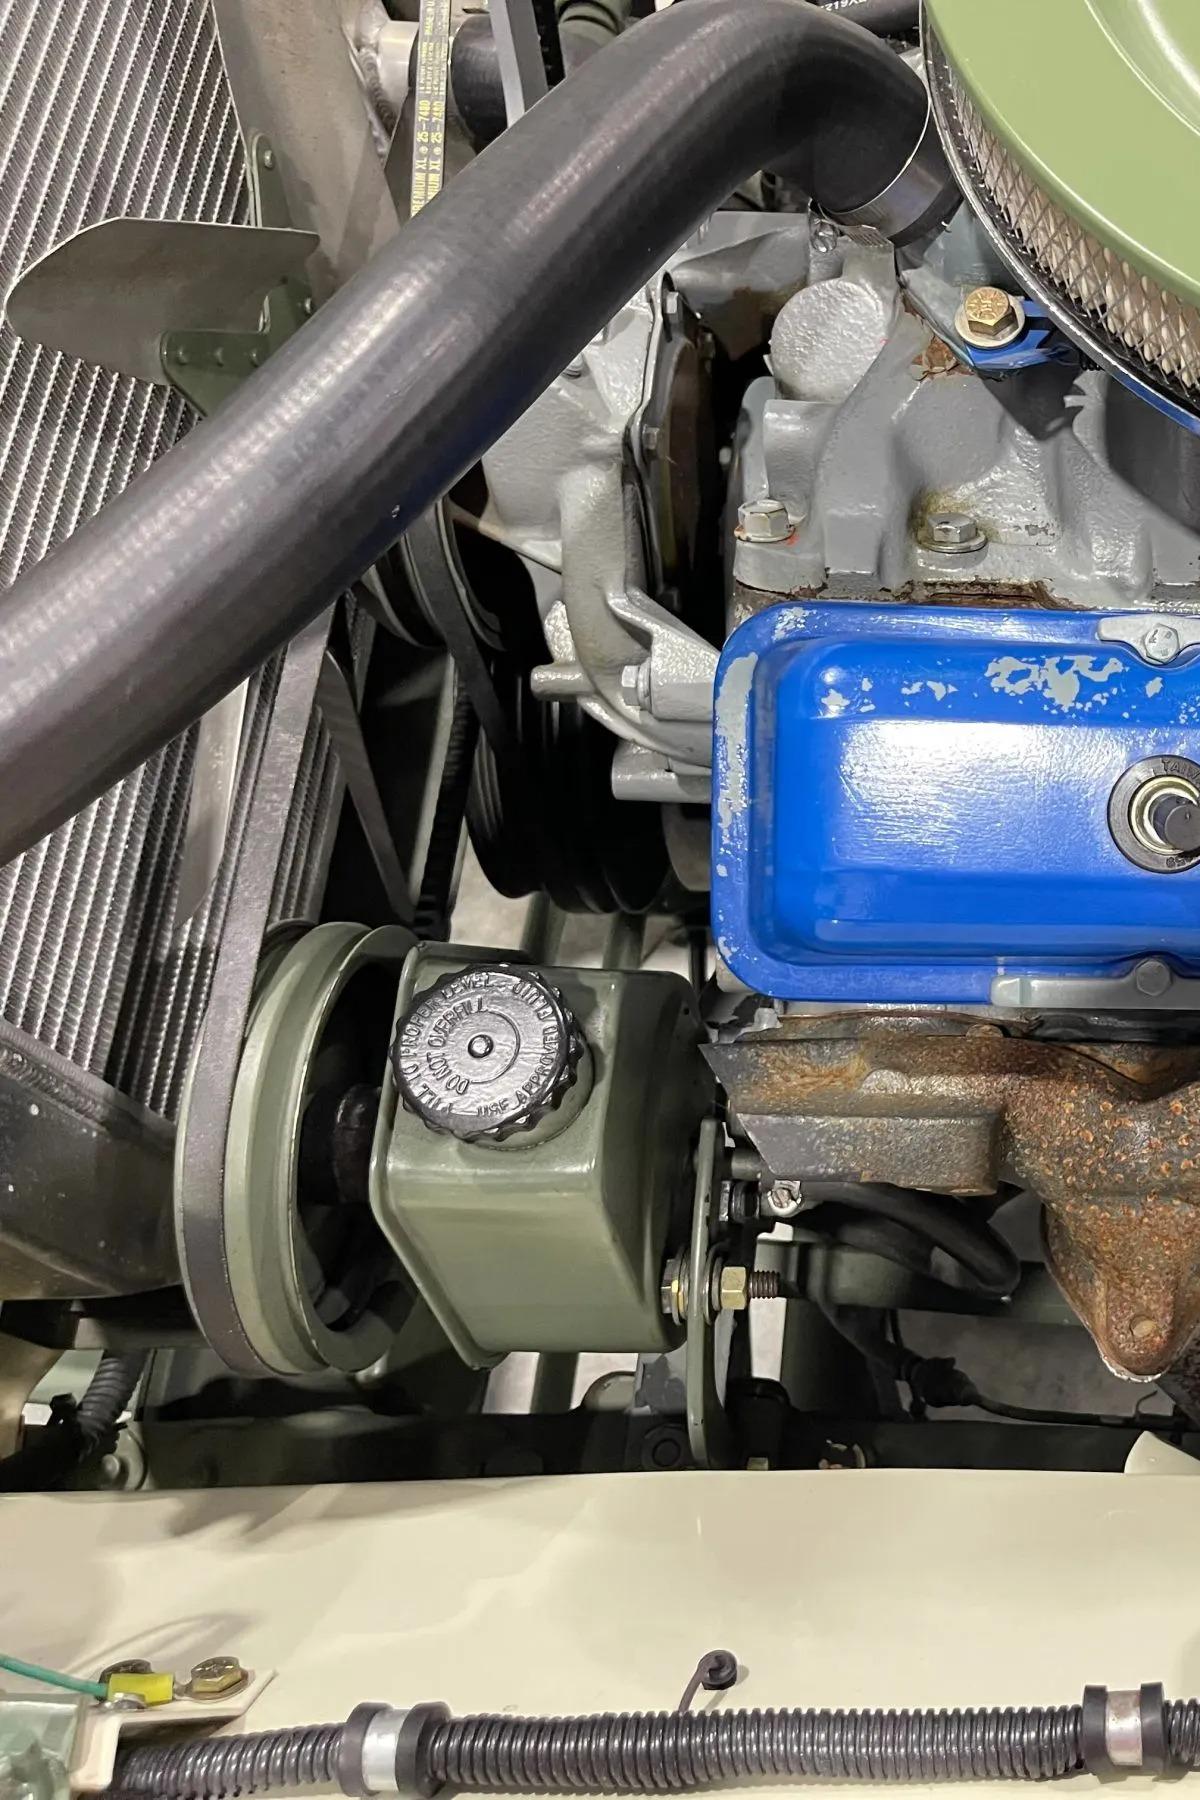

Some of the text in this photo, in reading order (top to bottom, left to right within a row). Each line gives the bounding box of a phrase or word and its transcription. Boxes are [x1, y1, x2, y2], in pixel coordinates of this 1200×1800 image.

[440, 972, 495, 1000] LEVEL
[511, 981, 556, 1021] FLUID
[401, 997, 448, 1057] PROPER
[426, 996, 489, 1095] DO NOT OVERFILL
[401, 1062, 421, 1084] TO
[514, 1024, 560, 1109] APPROVED
